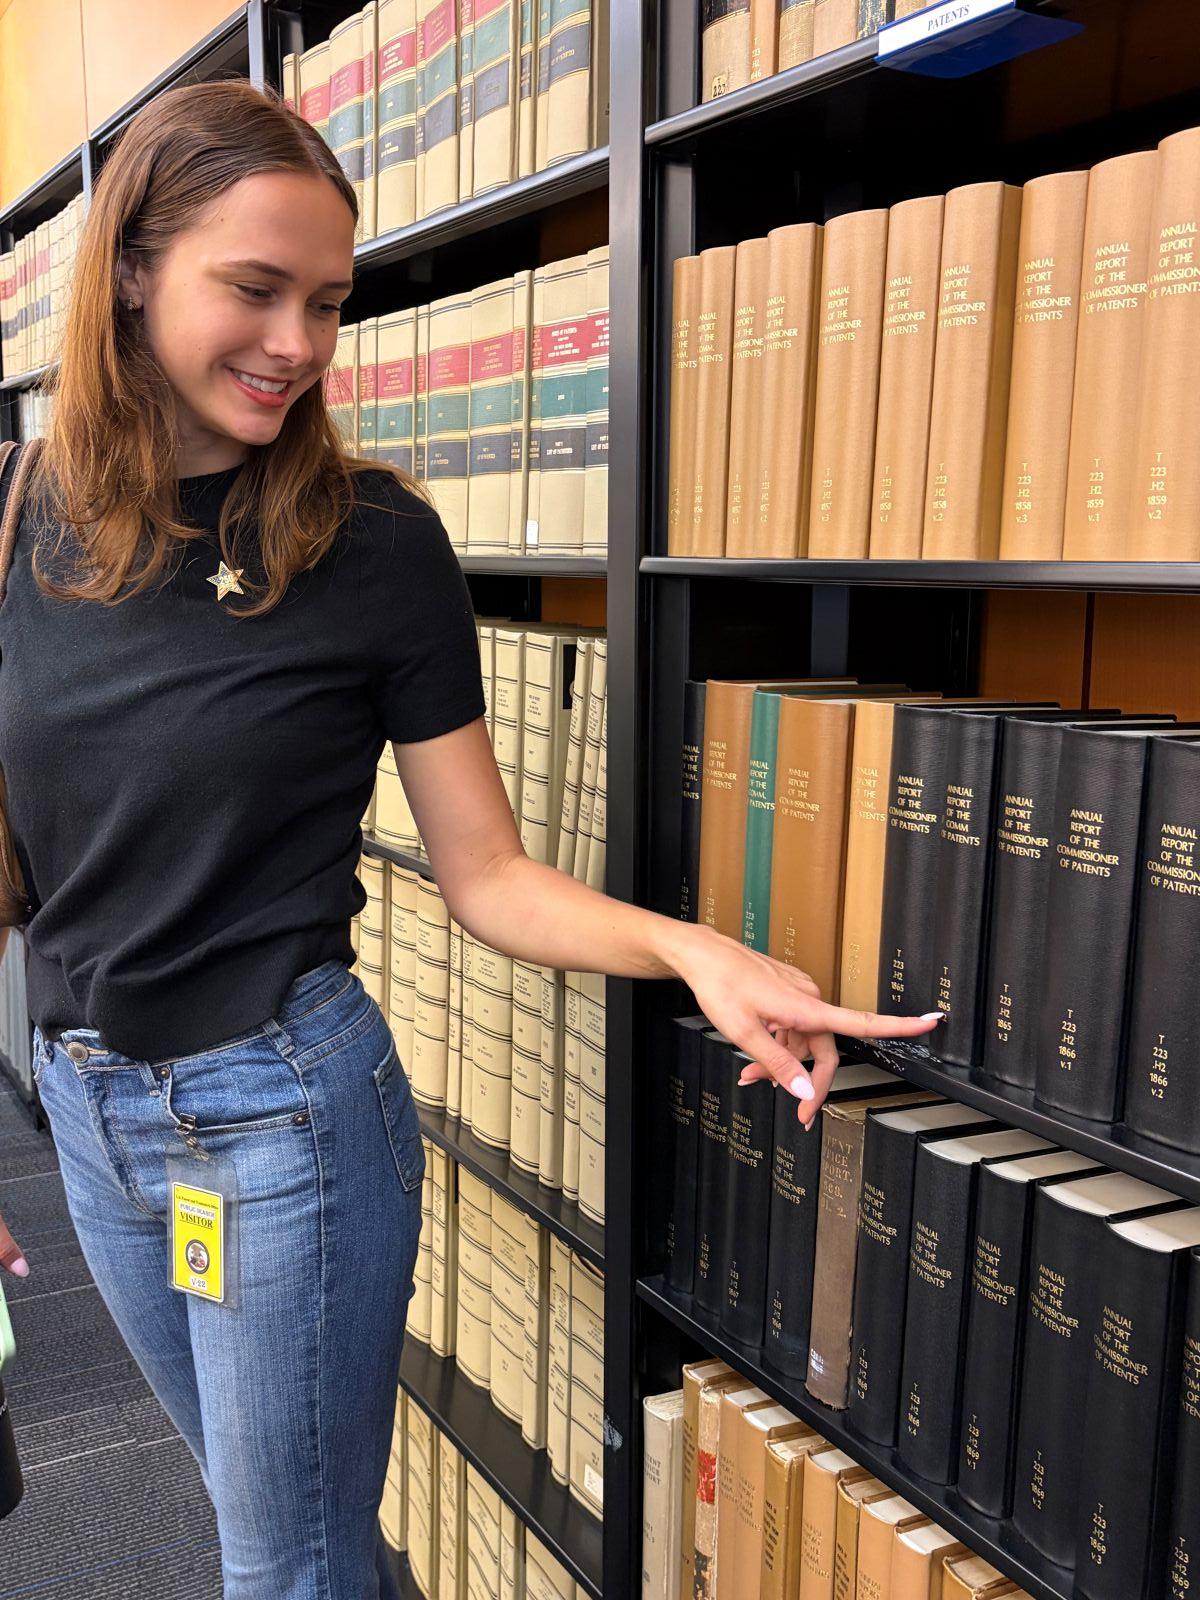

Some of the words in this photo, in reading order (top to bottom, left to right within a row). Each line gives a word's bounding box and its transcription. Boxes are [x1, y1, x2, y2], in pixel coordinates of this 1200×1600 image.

[928, 4, 970, 31] PATENTS
[1160, 222, 1198, 238] ANNUAL
[1096, 242, 1131, 257] ANNUAL
[1159, 237, 1195, 253] REPORT
[1095, 256, 1128, 270] REPORT
[1159, 257, 1170, 268] OF
[1173, 253, 1193, 264] THE
[1094, 275, 1105, 285] OF
[1109, 271, 1127, 281] THE
[1035, 285, 1052, 296] THE
[1083, 283, 1147, 301] COMMISSIONER
[1149, 288, 1160, 300] OF
[1086, 304, 1096, 314] OF
[1097, 298, 1138, 312] PATENTS
[1025, 310, 1062, 323] PATENTS
[1095, 458, 1101, 467] T
[1156, 452, 1163, 463] T
[1022, 462, 1028, 471] T
[1150, 467, 1166, 478] 223
[1017, 475, 1031, 485] 223
[1089, 472, 1104, 482] 223
[1015, 501, 1031, 511] 1858
[1087, 499, 1104, 509] 1859
[1147, 495, 1167, 505] 1859
[1016, 514, 1028, 523] v.3
[1088, 513, 1100, 522] v.1
[1148, 509, 1162, 520] v.2
[898, 775, 925, 788] ANNUAL
[898, 787, 922, 798] REPORT
[947, 784, 974, 798] ANNUAL
[897, 798, 906, 807] OF
[909, 798, 922, 810] THE
[947, 797, 971, 809] REPORT
[1005, 795, 1035, 808] ANNUAL
[889, 806, 938, 824] COMMISSIONER
[946, 807, 955, 817] OF
[957, 809, 970, 821] THE
[1005, 807, 1032, 820] REPORT
[1070, 809, 1105, 824] ANNUAL
[891, 819, 899, 828] OF
[899, 820, 930, 834] PATENTS
[946, 818, 969, 833] COMM
[1004, 819, 1013, 829] OF
[1016, 820, 1031, 833] THE
[1070, 821, 1102, 836] REPORT
[1161, 823, 1198, 840] ANNUAL
[947, 832, 981, 847] PATENTS
[1070, 834, 1081, 845] OF
[1083, 837, 1101, 850] THE
[1161, 836, 1195, 853] REPORT
[1006, 844, 1041, 859] PATENTS
[1056, 844, 1119, 866] COMMISSIONER
[1160, 850, 1172, 862] OF
[1175, 853, 1194, 867] THE
[1060, 857, 1070, 869] OF
[1071, 860, 1111, 878] PATENTS
[1150, 875, 1162, 887] OF
[896, 949, 901, 957] T
[893, 960, 905, 970] 223
[943, 966, 949, 975] T
[891, 981, 904, 993] 1865
[940, 977, 951, 988] 223
[1003, 984, 1009, 992] T
[937, 999, 951, 1012] 1865
[999, 995, 1012, 1007] 223
[1066, 1008, 1073, 1018] T
[997, 1018, 1012, 1031] 1865
[1061, 1020, 1076, 1033] 223
[1061, 1034, 1075, 1046] .H2
[1158, 1034, 1165, 1044] T
[1059, 1046, 1076, 1059] 1866
[1152, 1046, 1168, 1060] 223
[1060, 1060, 1072, 1071] v.1
[1152, 1060, 1166, 1073] .H2
[1149, 1072, 1168, 1087] 1866
[1150, 1088, 1164, 1099] v.2
[864, 1181, 886, 1200] ANNUAL
[864, 1191, 883, 1210] REPORT
[180, 1212, 213, 1229] VISITOR
[871, 1208, 883, 1221] THE
[865, 1225, 891, 1247] PATENTS
[916, 1220, 939, 1242] ANNUAL
[916, 1231, 938, 1252] REPORT
[977, 1235, 1002, 1257] ANNUAL
[915, 1243, 923, 1254] OF
[924, 1248, 937, 1263] THE
[977, 1246, 1000, 1267] REPORT
[976, 1258, 983, 1270] OF
[985, 1264, 999, 1279] THE
[1039, 1264, 1067, 1287] ANNUAL
[916, 1266, 945, 1289] PATENTS
[1039, 1275, 1064, 1297] REPORT
[976, 1283, 1008, 1306] PATENTS
[1039, 1288, 1047, 1299] OF
[1049, 1295, 1063, 1310] THE
[1032, 1306, 1039, 1318] OF
[1040, 1313, 1072, 1338] PATENTS
[1103, 1305, 1133, 1331] ANNUAL
[1103, 1317, 1131, 1342] REPORT
[1102, 1330, 1112, 1343] OF
[1114, 1338, 1129, 1355] THE
[1093, 1333, 1149, 1377] COMMISSIONER
[859, 1357, 868, 1369] 223
[1095, 1349, 1103, 1362] OF
[1103, 1358, 1140, 1386] PATENTS
[910, 1391, 920, 1405] 223
[972, 1414, 977, 1423] T
[968, 1423, 980, 1438] 223
[966, 1445, 980, 1461] 1869
[1037, 1450, 1042, 1460] T
[1033, 1460, 1044, 1475] 223
[1031, 1483, 1045, 1500] 1869
[1098, 1502, 1104, 1513] T
[1092, 1512, 1107, 1530] 223
[1090, 1536, 1107, 1555] 1869
[1179, 1536, 1186, 1547] T
[1174, 1546, 1189, 1563] 223
[1171, 1570, 1190, 1590] 1869
